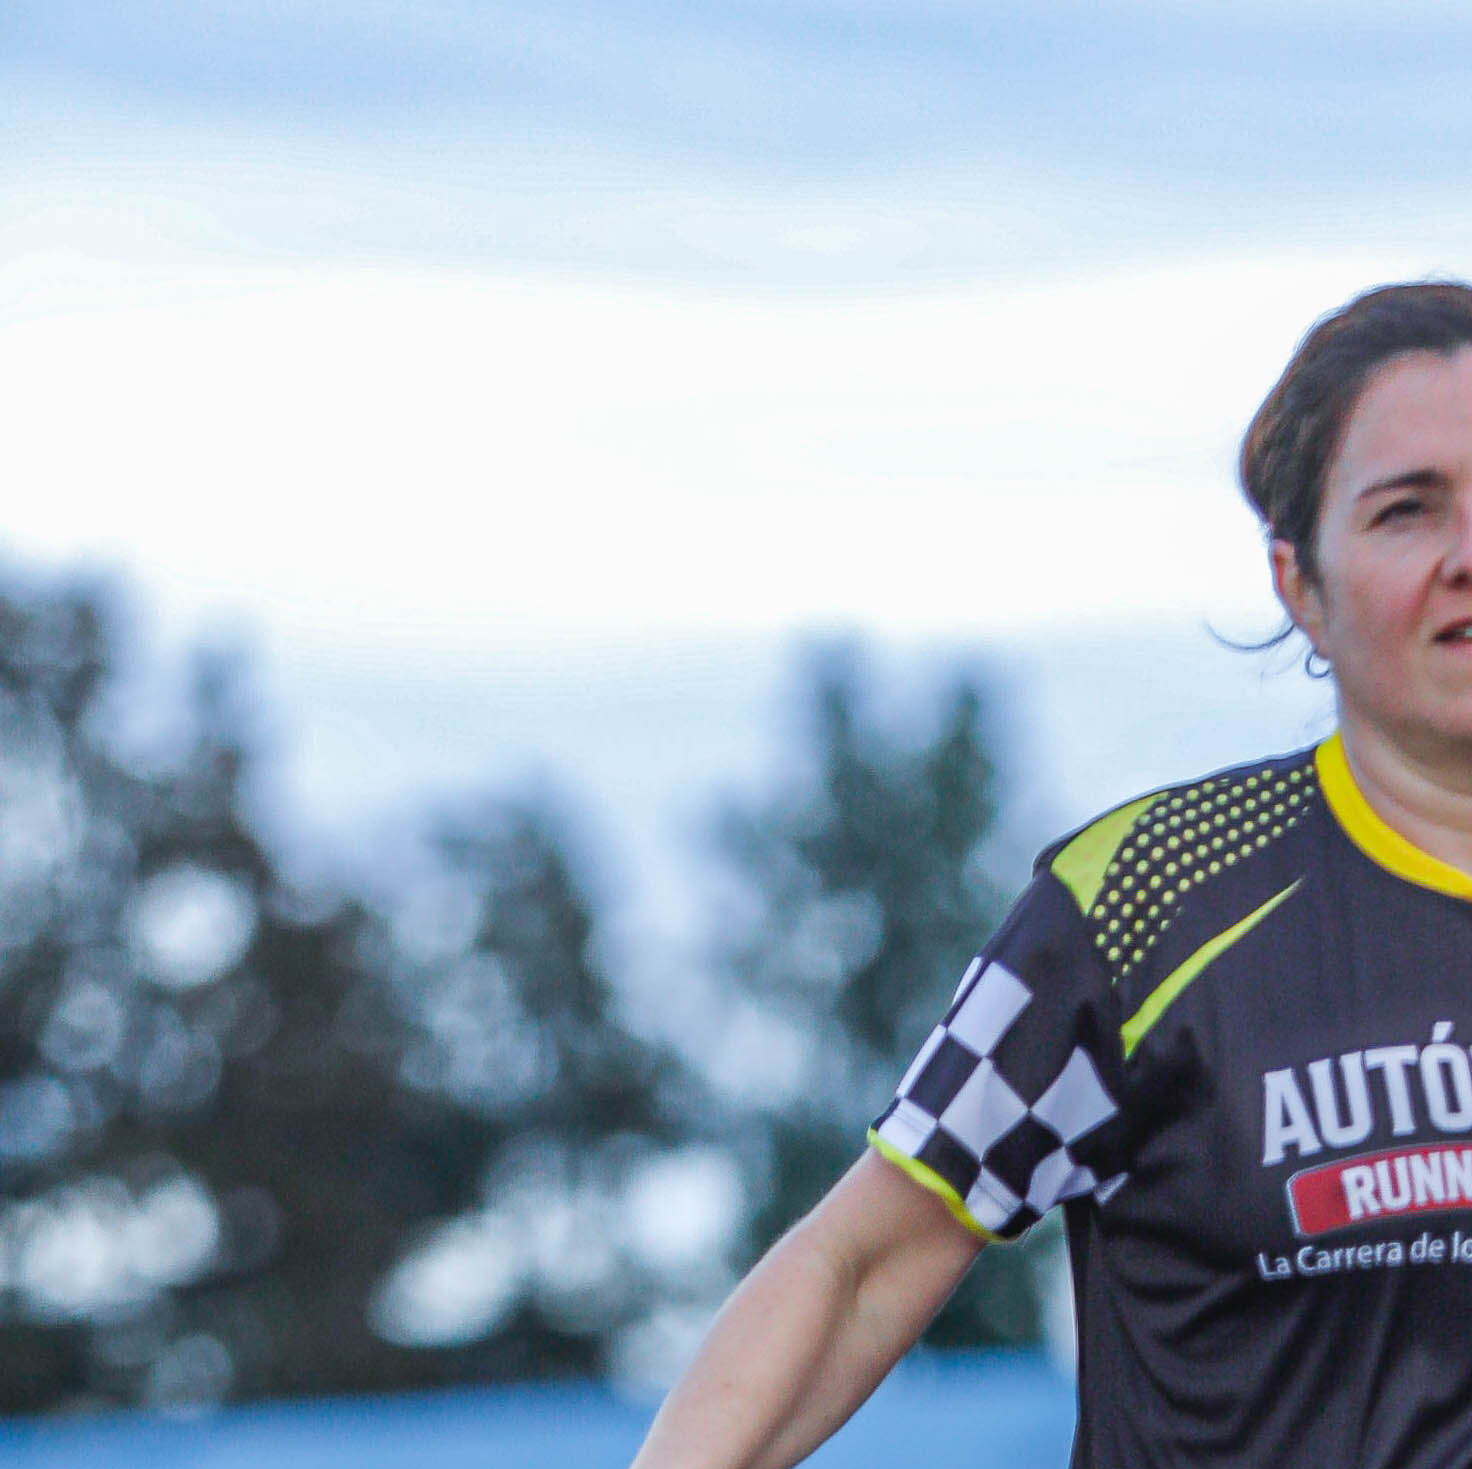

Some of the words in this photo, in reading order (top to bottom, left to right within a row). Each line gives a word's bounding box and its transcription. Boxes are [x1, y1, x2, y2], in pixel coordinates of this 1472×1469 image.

[1258, 1252, 1291, 1281] La
[1297, 1242, 1402, 1277] Carrera
[1410, 1232, 1445, 1263] de
